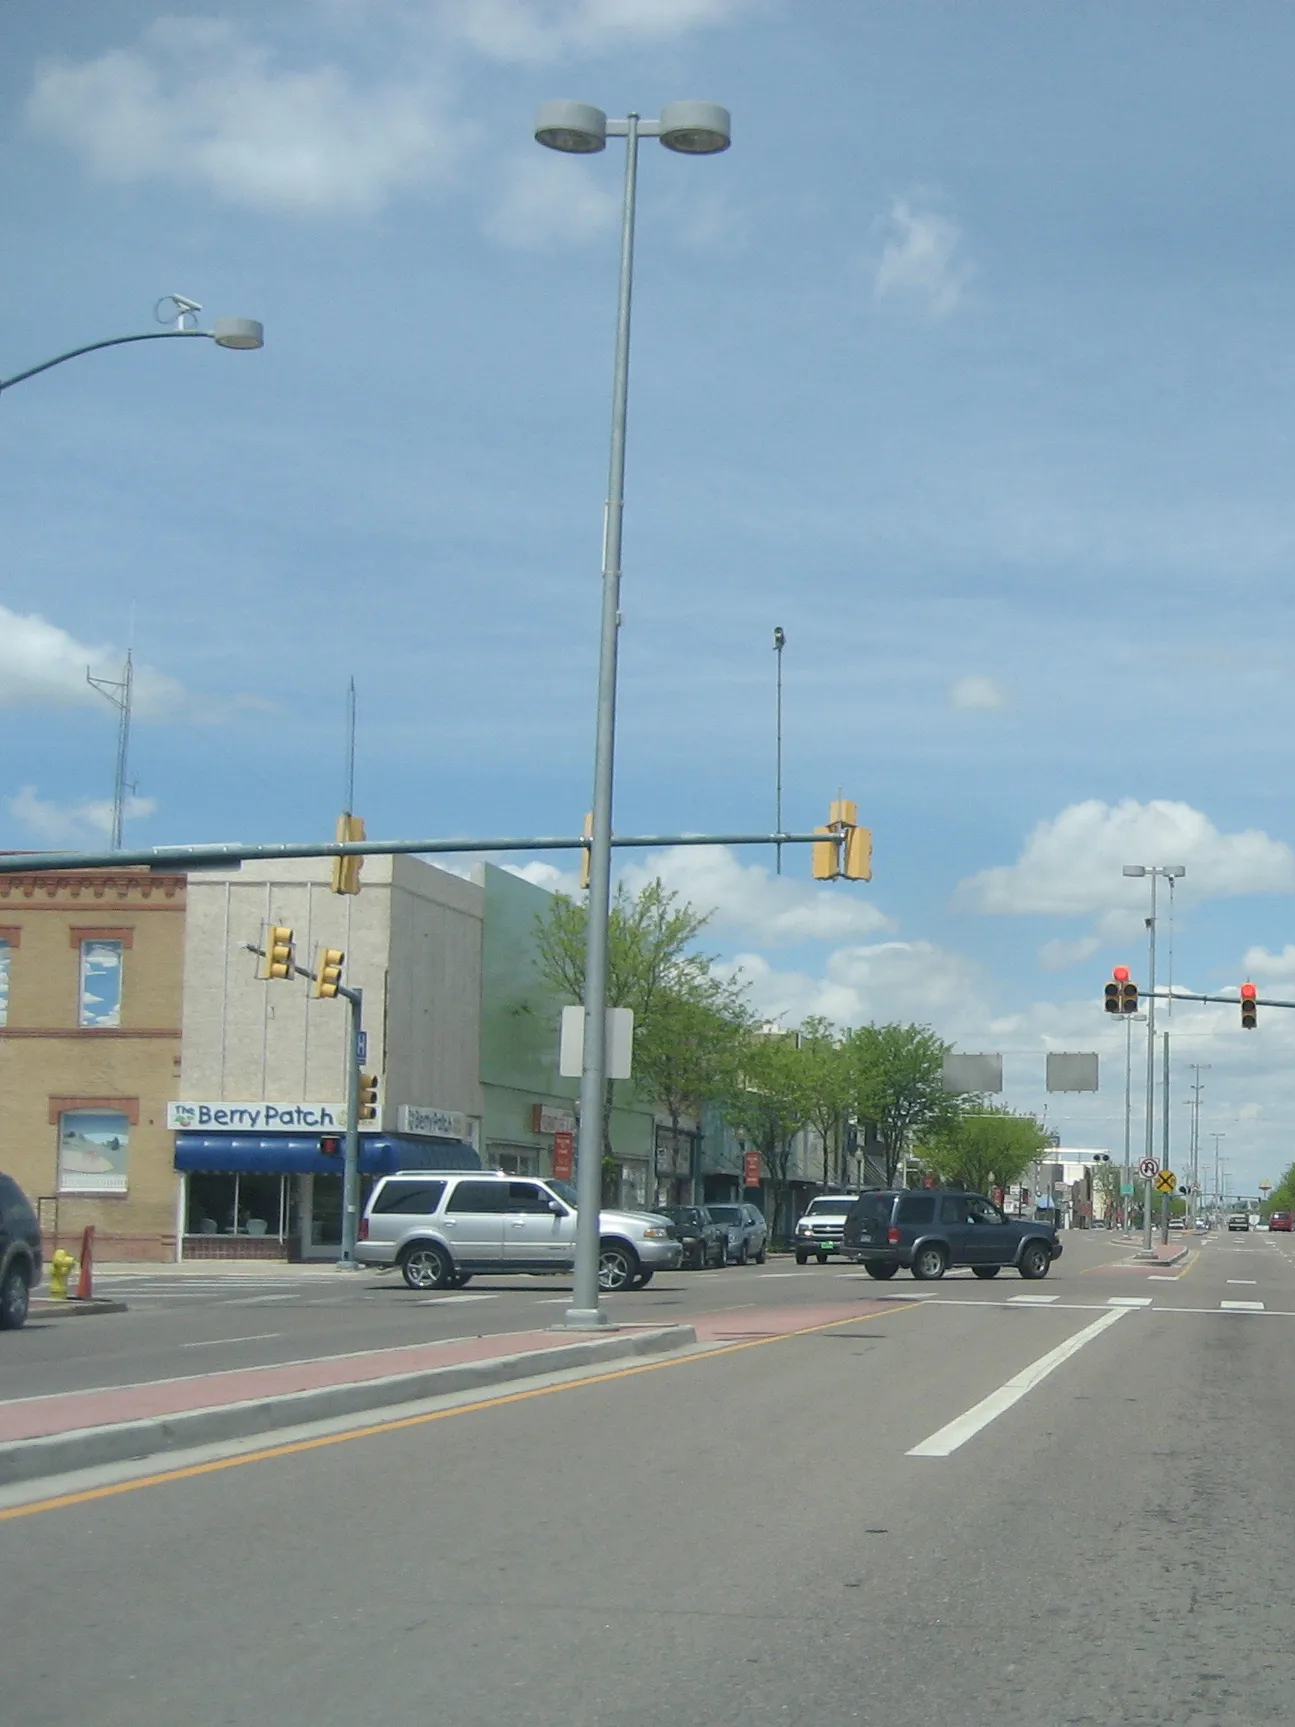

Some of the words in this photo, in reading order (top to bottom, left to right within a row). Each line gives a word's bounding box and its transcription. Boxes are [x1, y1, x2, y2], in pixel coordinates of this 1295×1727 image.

[174, 1105, 196, 1116] The
[198, 1105, 261, 1128] Berry
[264, 1105, 334, 1127] Patch
